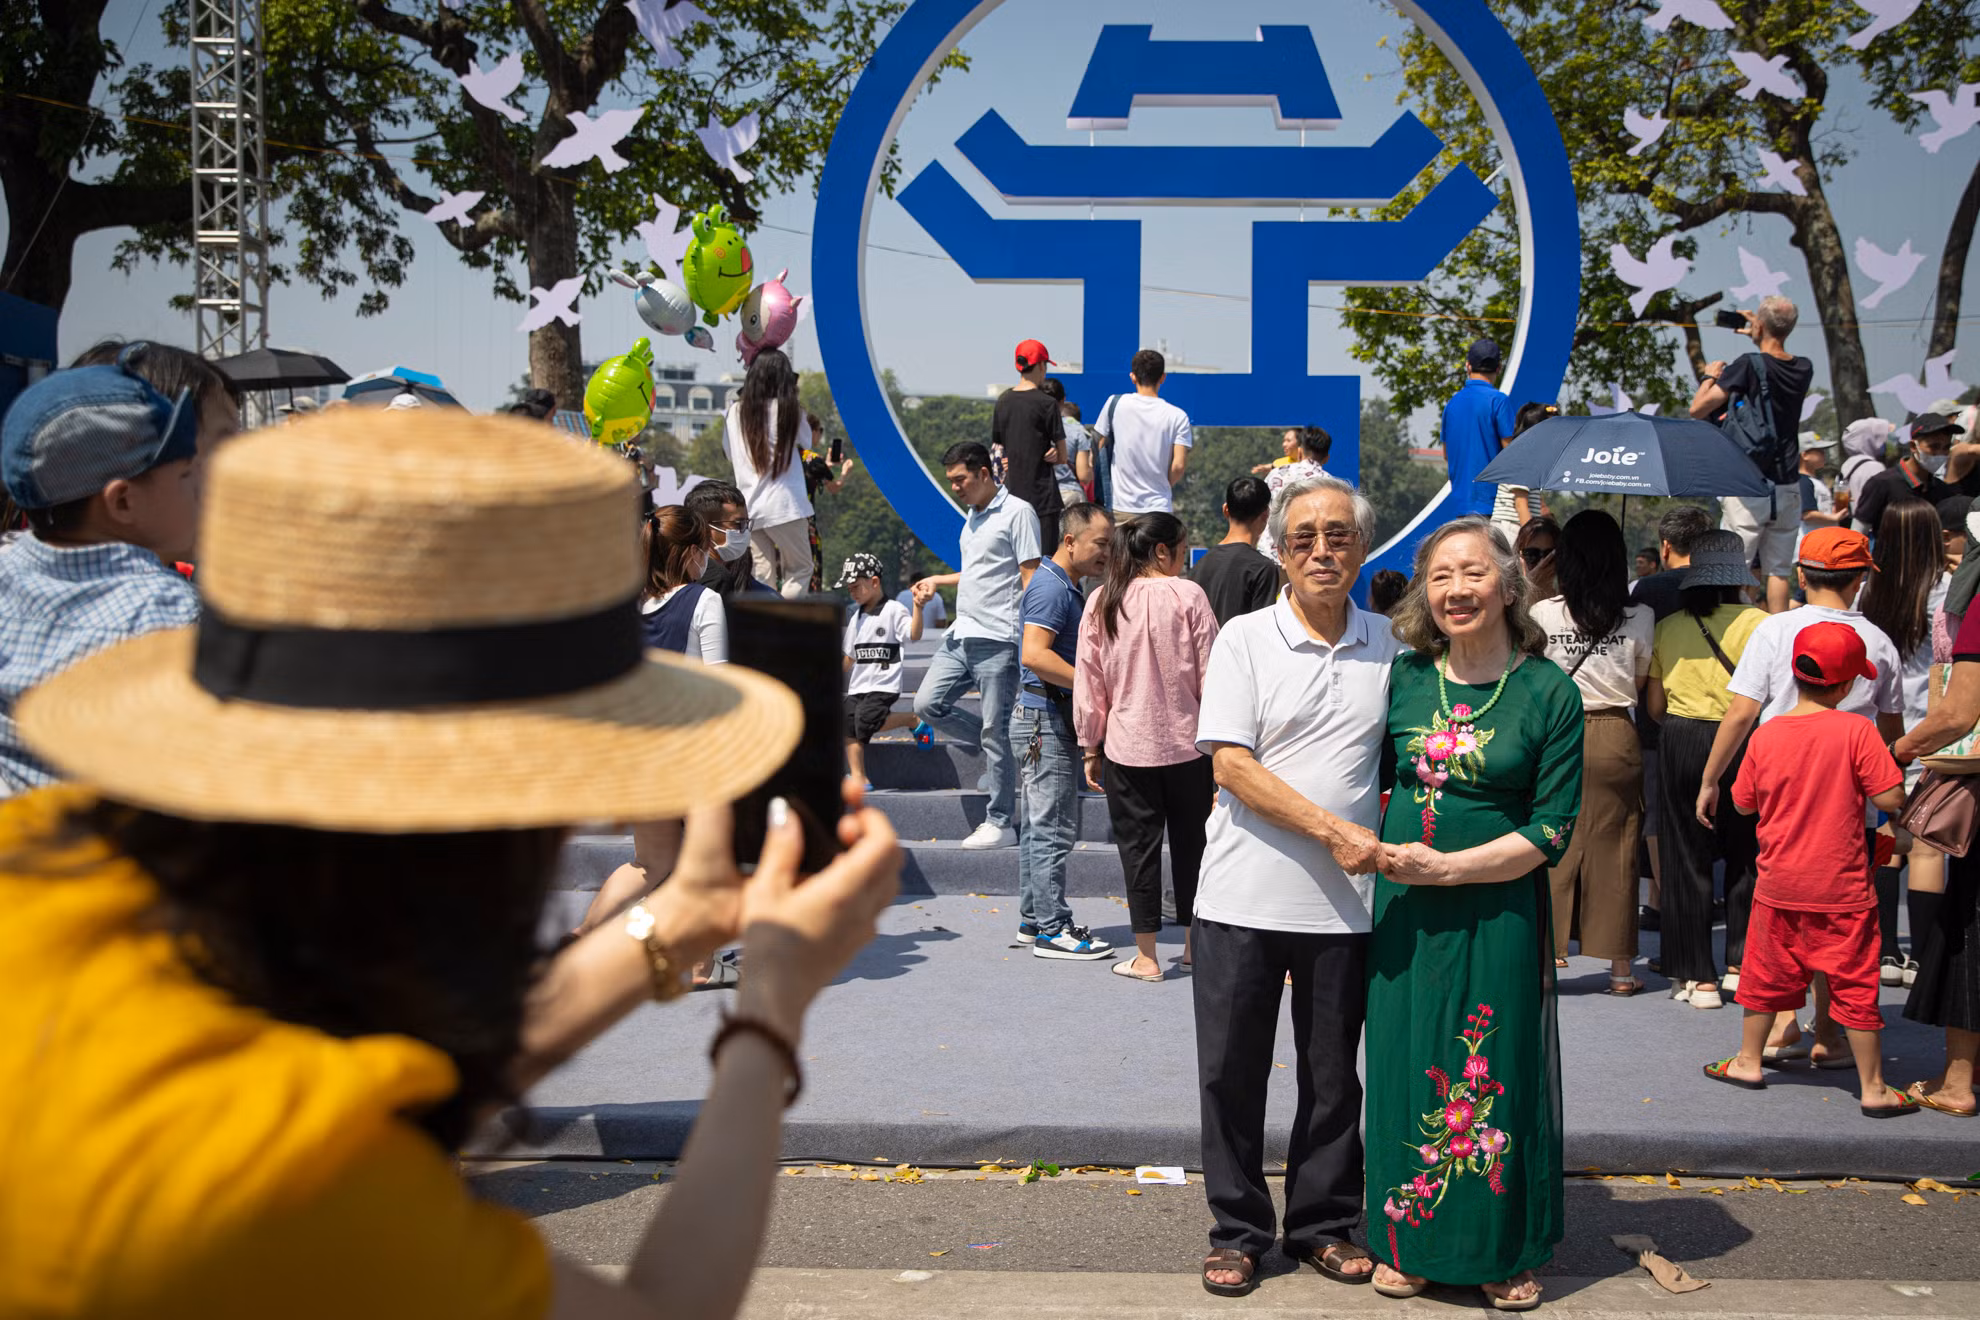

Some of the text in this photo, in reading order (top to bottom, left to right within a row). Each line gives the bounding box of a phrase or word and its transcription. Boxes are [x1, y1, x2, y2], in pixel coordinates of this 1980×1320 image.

[1581, 446, 1638, 466] Joie
[1589, 472, 1640, 481] joiebaby.com.vn
[1549, 634, 1627, 646] STEAMOAT
